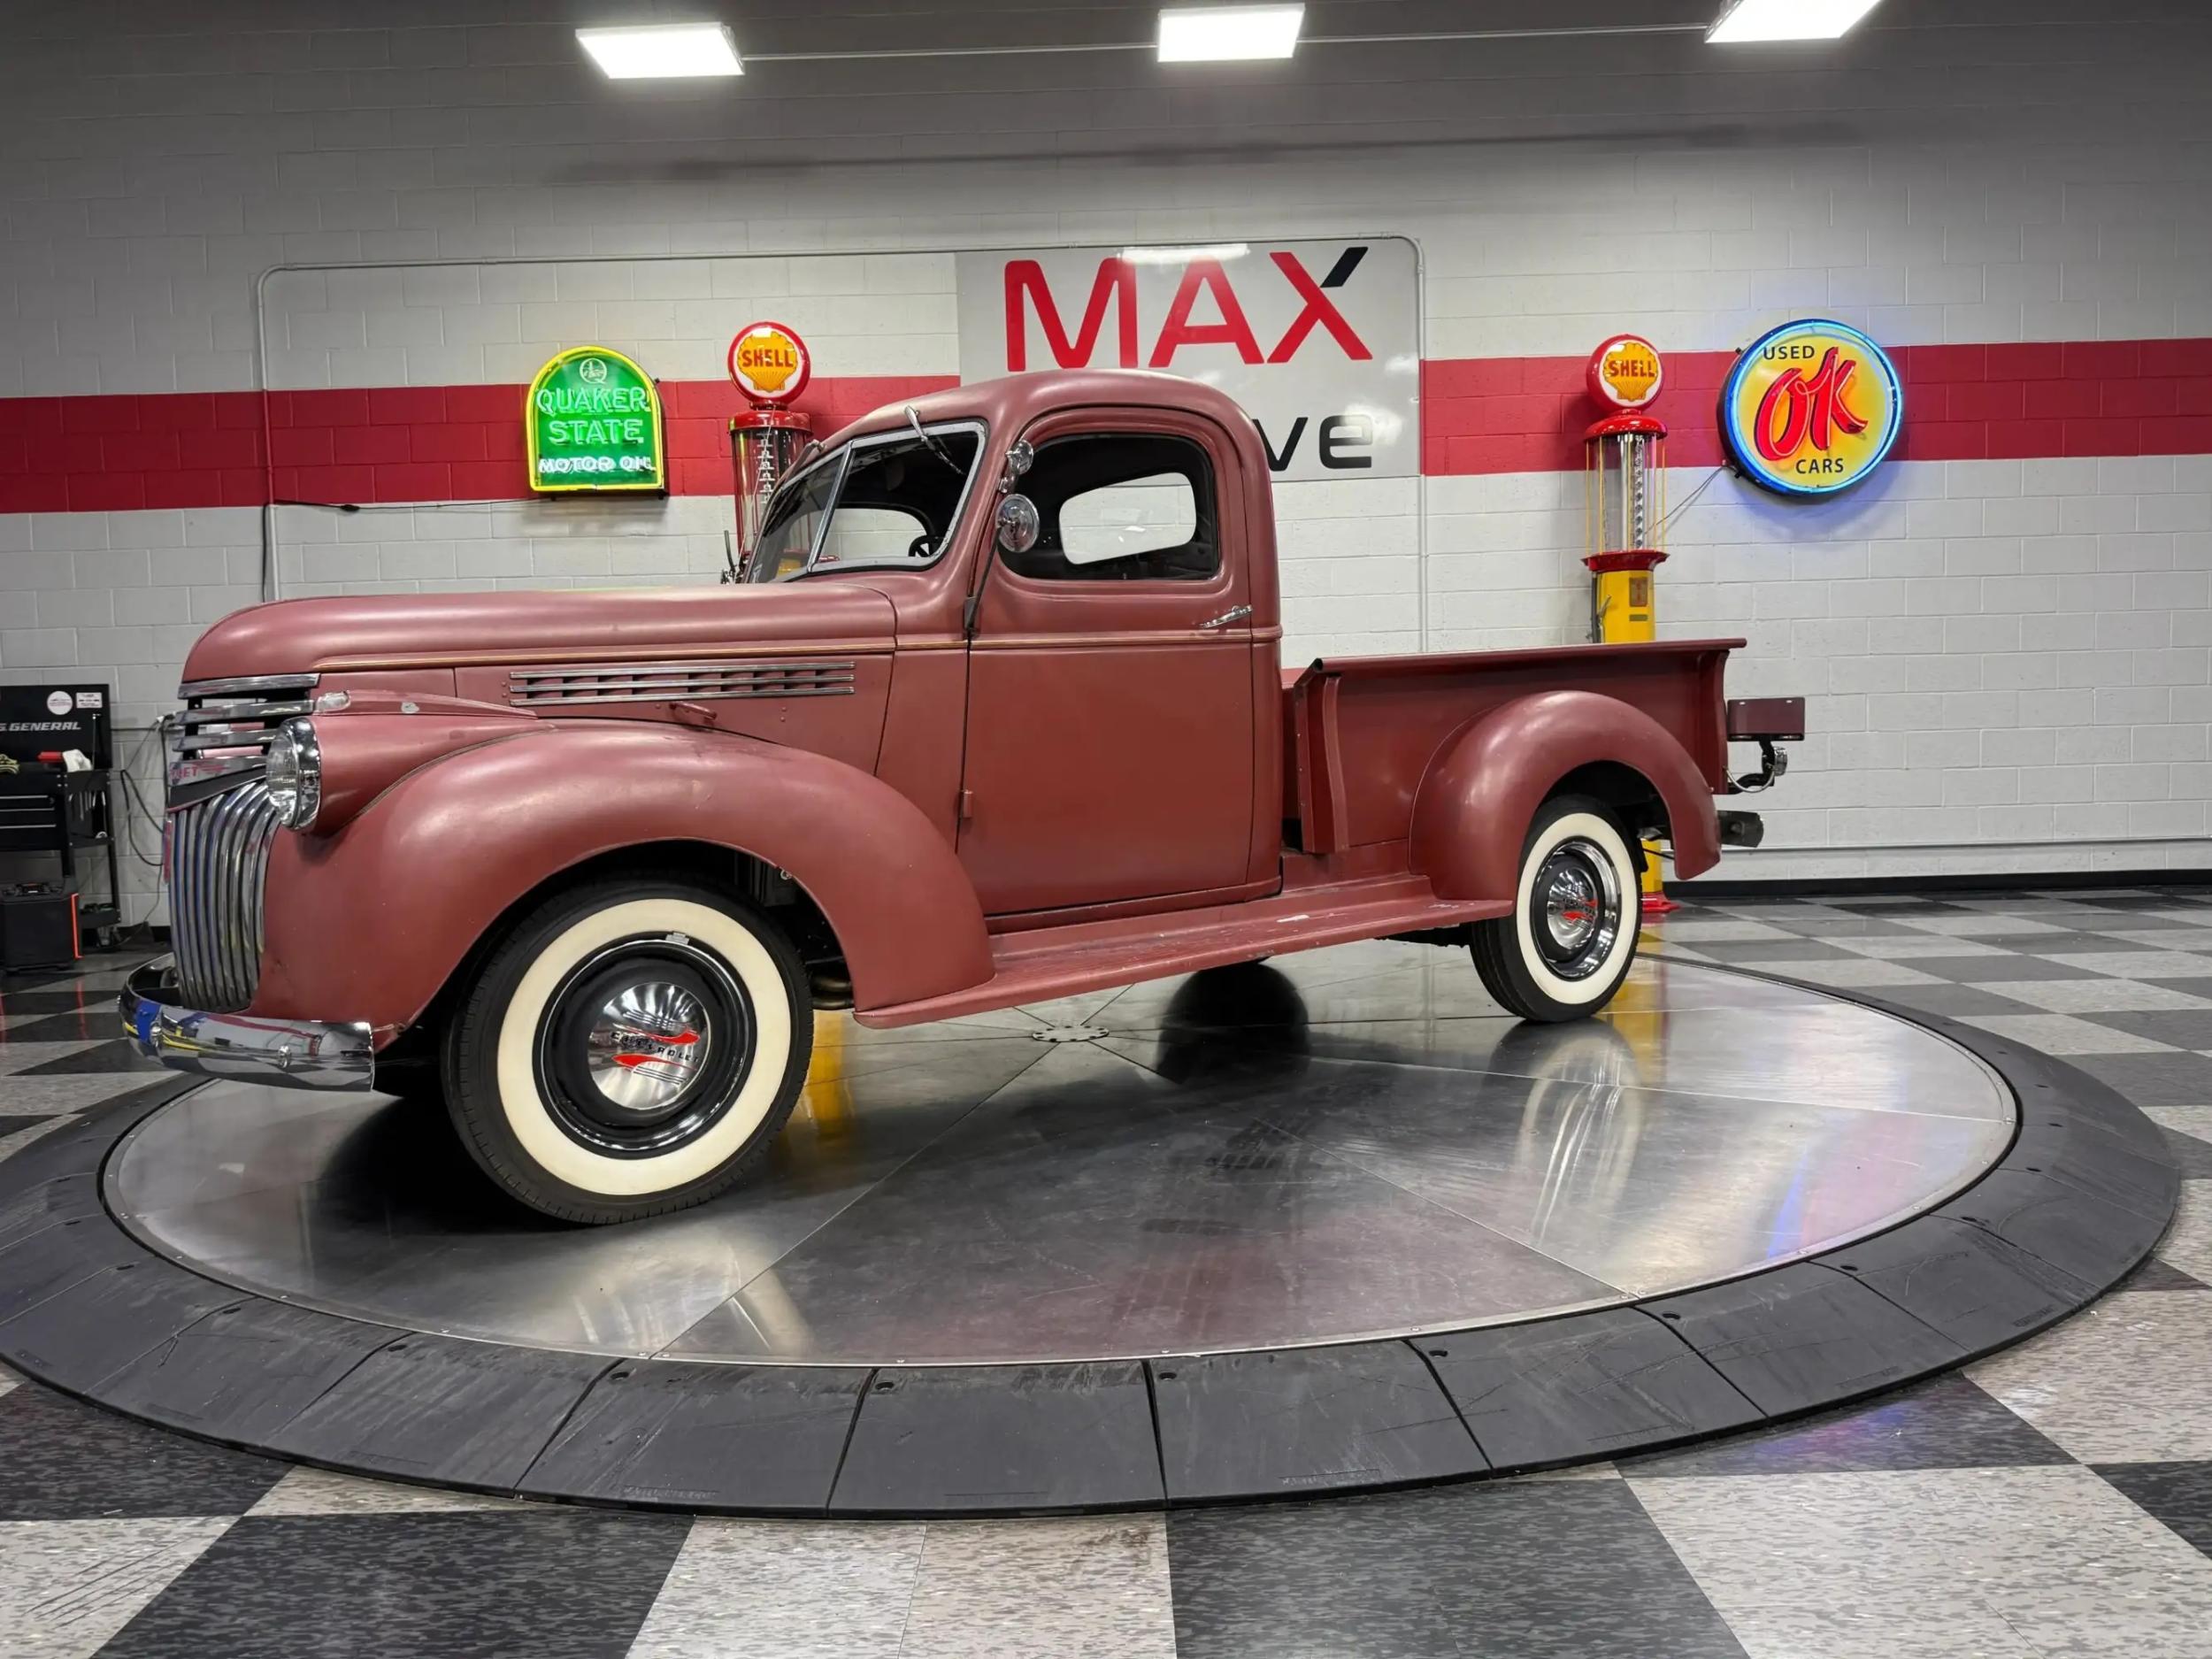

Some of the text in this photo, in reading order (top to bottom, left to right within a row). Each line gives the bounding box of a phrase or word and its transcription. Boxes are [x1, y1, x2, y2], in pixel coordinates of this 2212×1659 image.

[1004, 246, 1373, 372] MAX
[741, 349, 794, 368] SHELL
[1763, 345, 1815, 360] USED
[1608, 359, 1656, 378] SHELL
[536, 387, 651, 417] QUAKER
[1754, 346, 1869, 461] OK
[549, 419, 644, 444] STATE
[538, 455, 657, 474] MOTOR OIL
[1795, 458, 1844, 473] CARS
[9, 721, 81, 732] GENERAL
